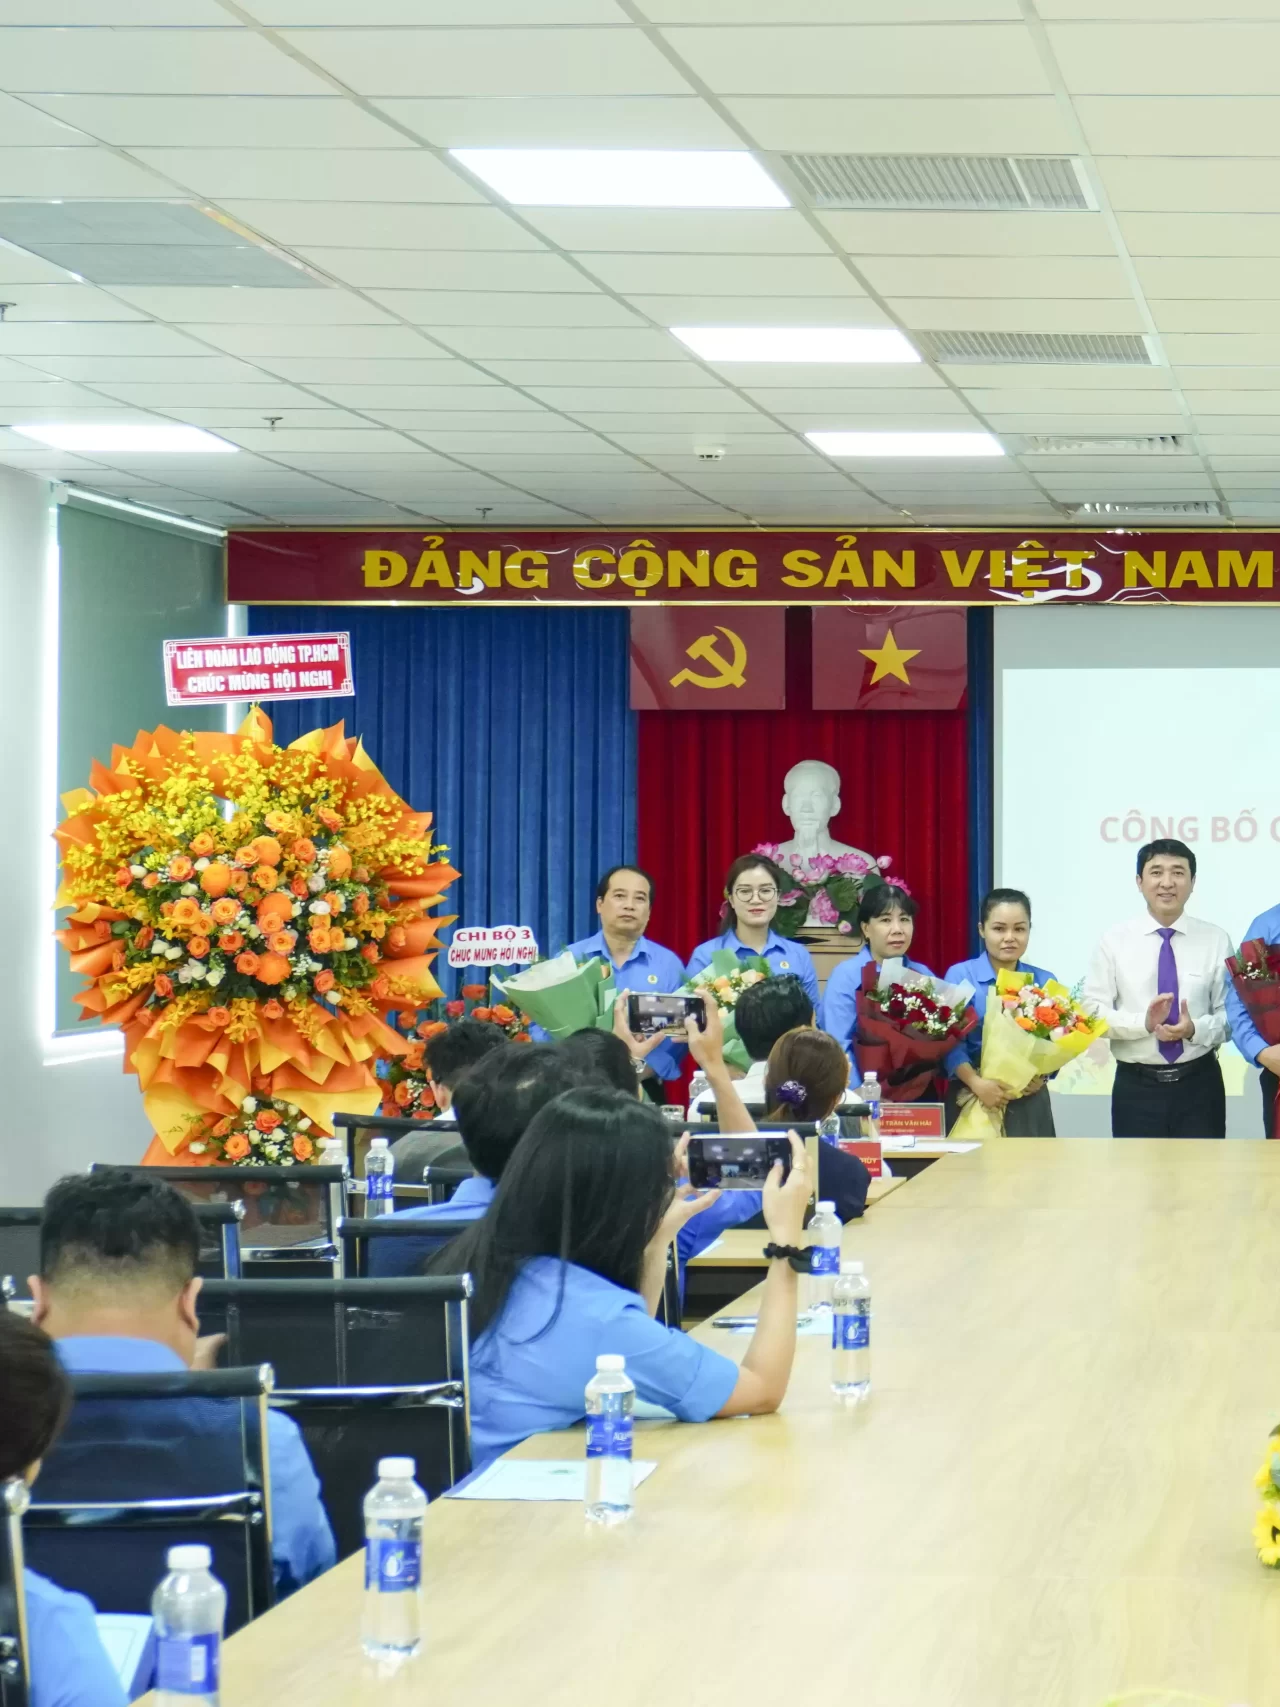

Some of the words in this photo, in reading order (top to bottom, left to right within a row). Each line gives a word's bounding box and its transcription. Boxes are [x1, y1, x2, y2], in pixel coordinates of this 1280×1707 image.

[361, 535, 549, 588] ĐẢNG
[572, 539, 758, 597] CỘNG
[781, 535, 916, 588] SẢN
[940, 540, 1096, 598] VIỆT
[1123, 549, 1274, 589] NAM
[176, 647, 203, 669] LIÊN
[205, 645, 239, 668] ĐOÀN
[240, 647, 262, 666] LAO
[264, 643, 296, 668] ĐỘNG
[297, 643, 340, 663] TP.HCM
[187, 673, 226, 693] CHÚC
[228, 670, 270, 691] MỪNG
[273, 669, 297, 692] HỘI
[299, 669, 333, 690] NGHỊ
[1100, 809, 1200, 843] CÔNG
[1210, 808, 1258, 843] BỐ
[456, 931, 487, 942] CHI
[492, 927, 517, 943] BỘ
[521, 929, 531, 940] 3
